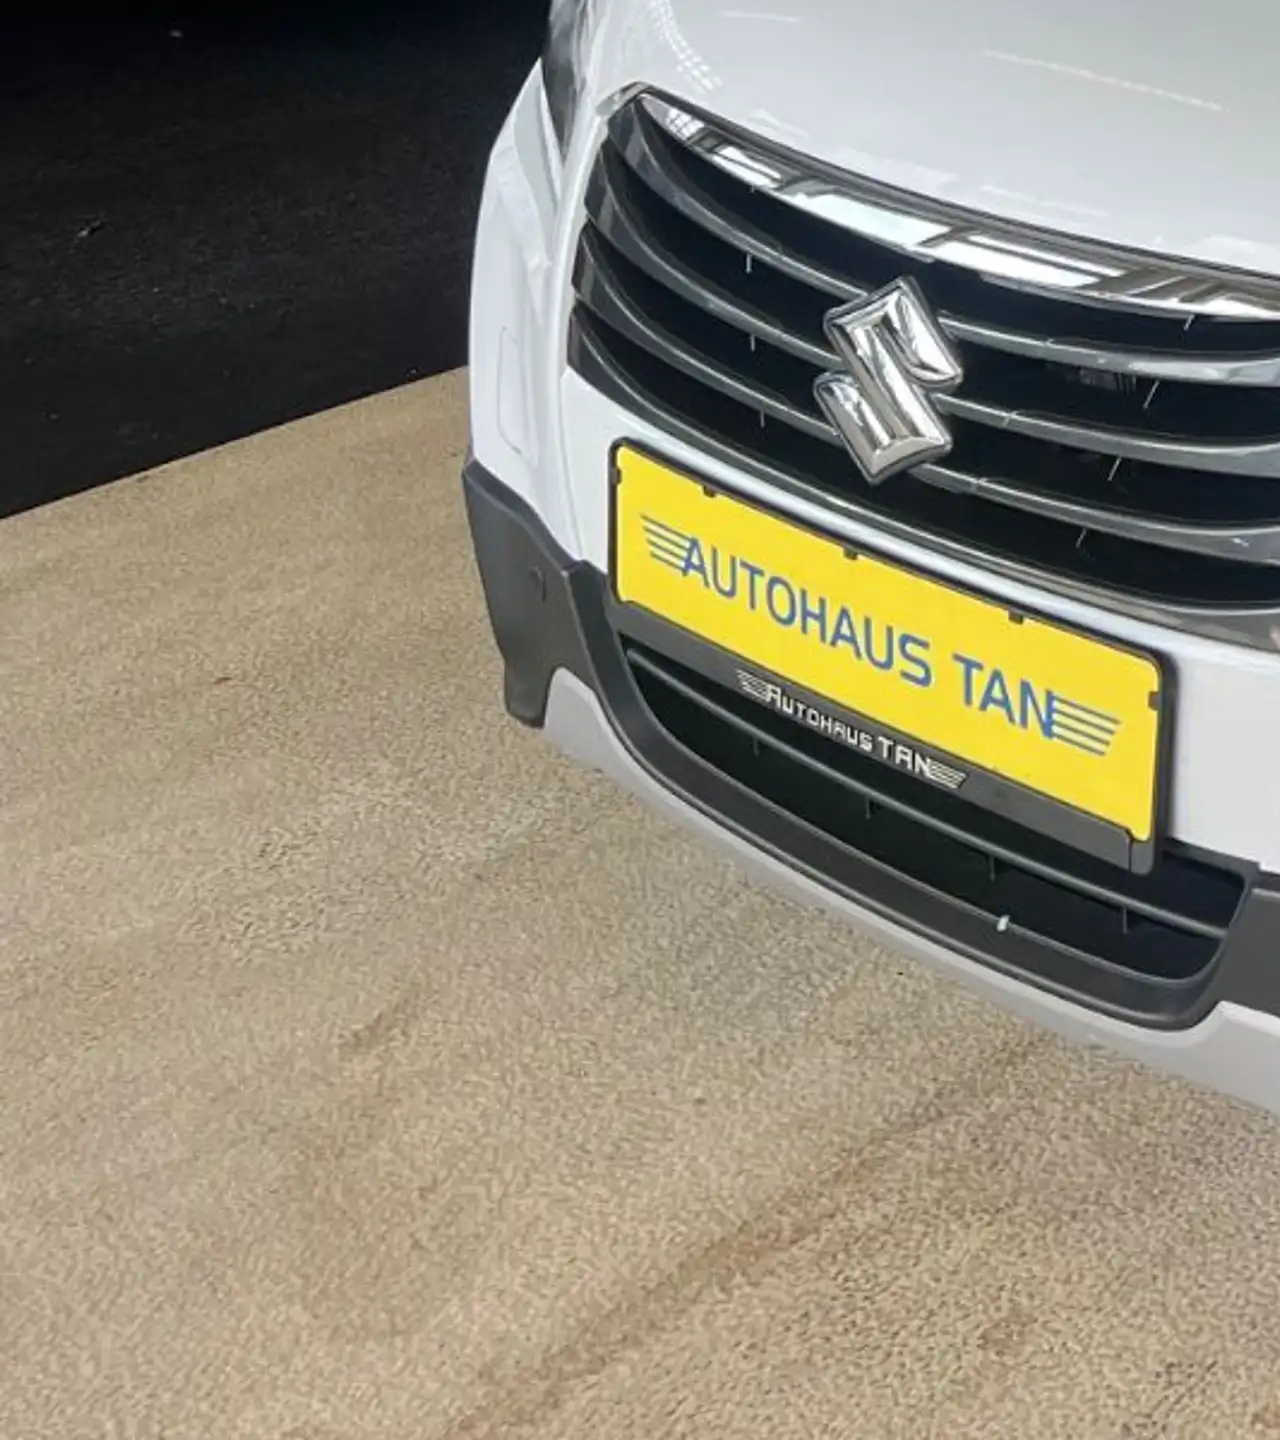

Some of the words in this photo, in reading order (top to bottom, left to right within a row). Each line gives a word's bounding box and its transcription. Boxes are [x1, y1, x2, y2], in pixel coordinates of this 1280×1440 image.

[682, 536, 931, 688] AUTOHAUS
[952, 653, 1057, 740] TAN
[878, 736, 932, 776] TAN
